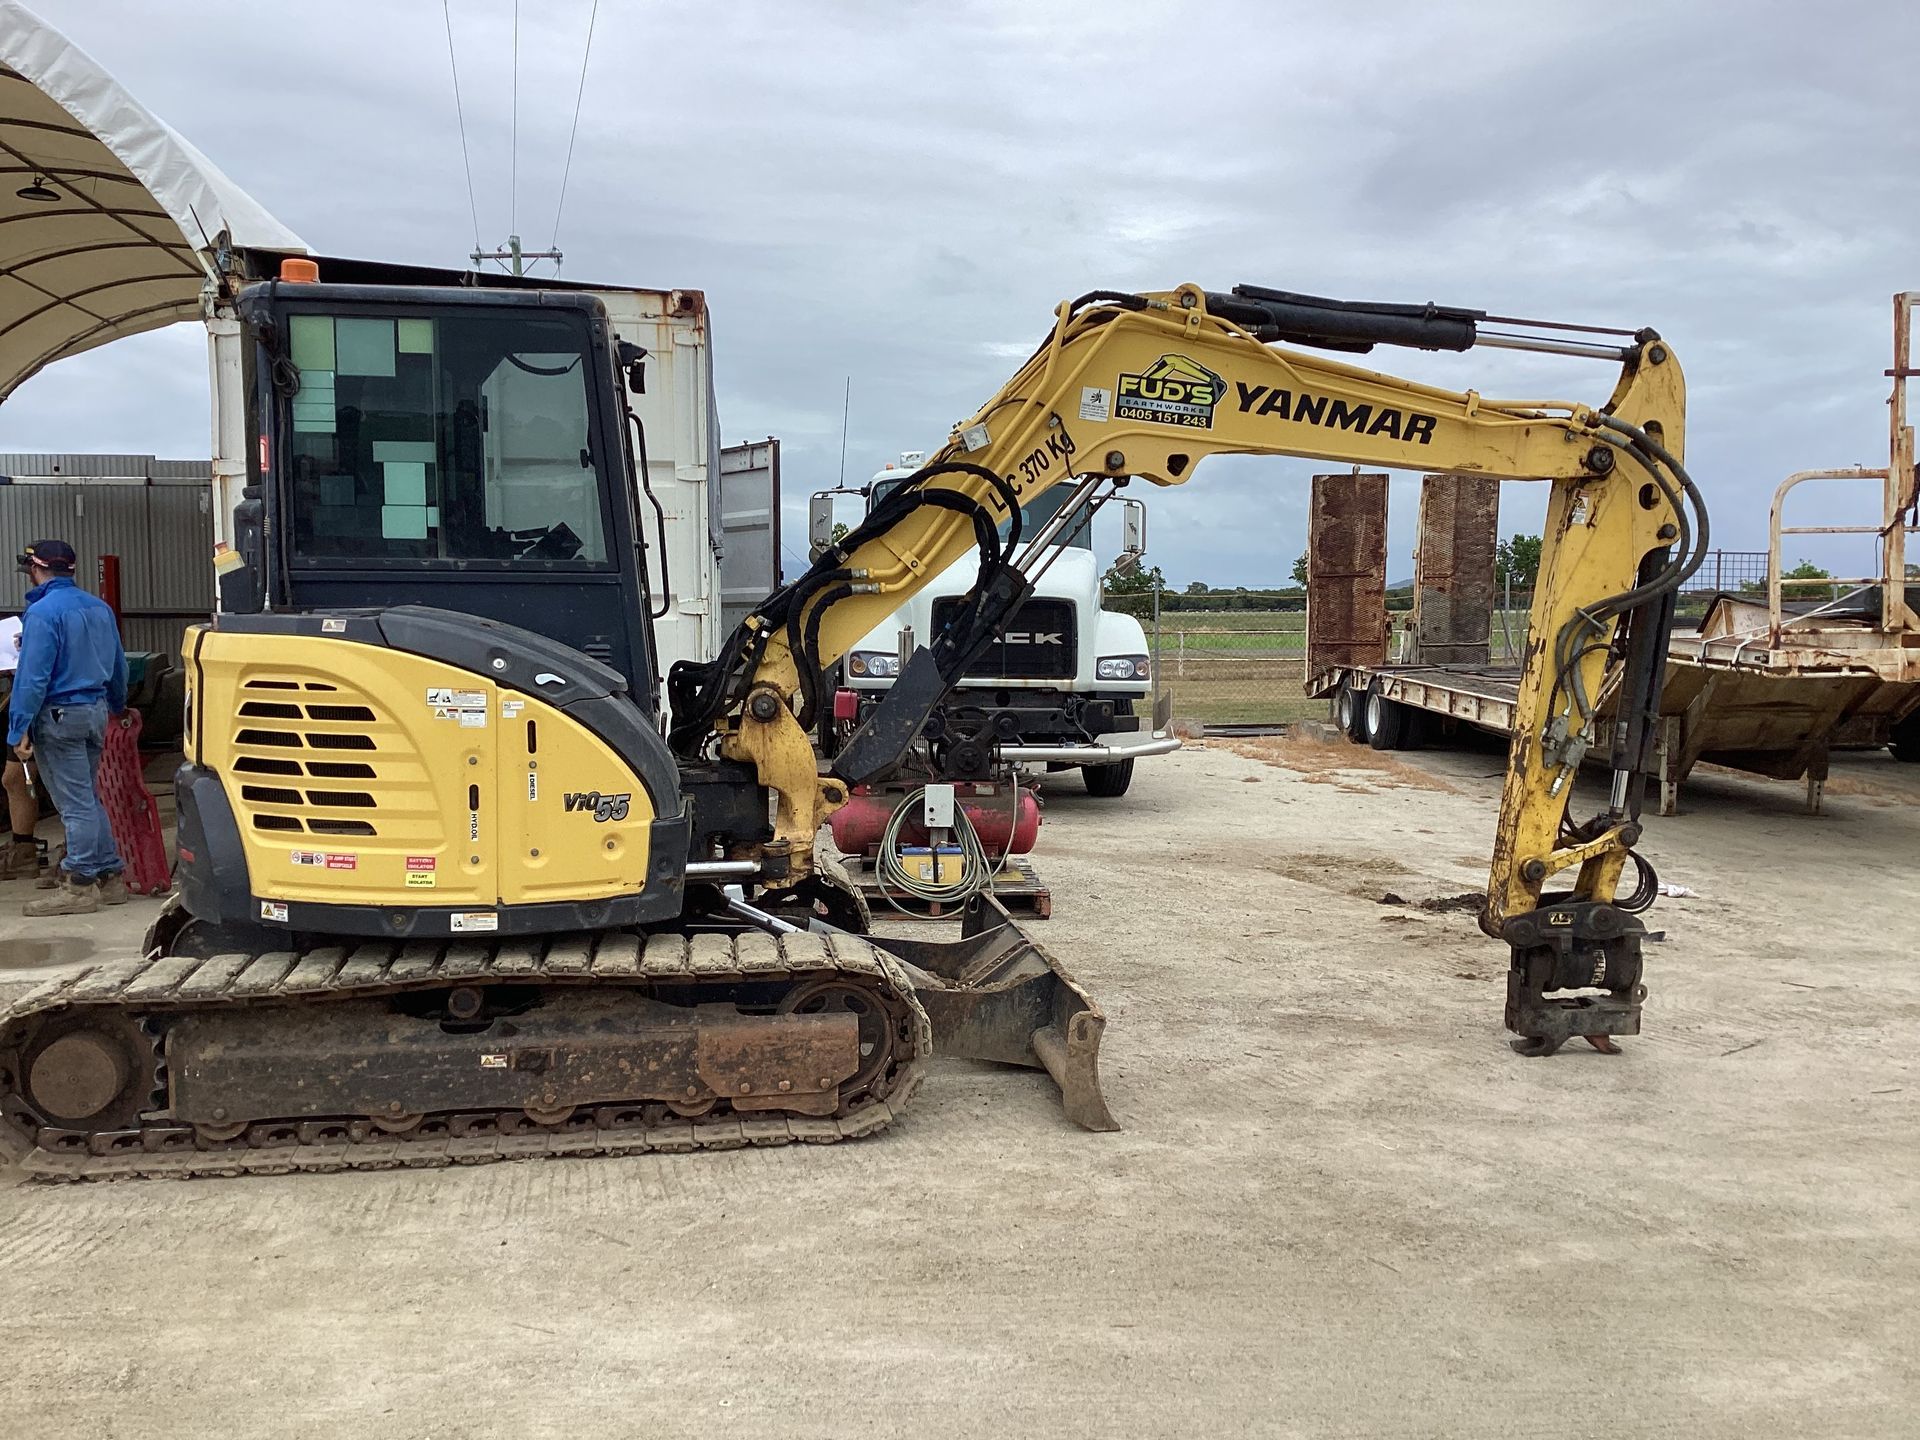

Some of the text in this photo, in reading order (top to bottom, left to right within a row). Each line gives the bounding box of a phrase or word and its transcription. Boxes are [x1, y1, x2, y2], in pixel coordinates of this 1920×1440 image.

[1119, 376, 1213, 405] FUD'S
[1120, 407, 1153, 420] 0405
[1156, 412, 1179, 424] 151
[1183, 415, 1207, 427] 243
[1125, 398, 1205, 415] EARTHWORKS
[1236, 381, 1438, 445] YANMAR
[1019, 448, 1050, 484] 370
